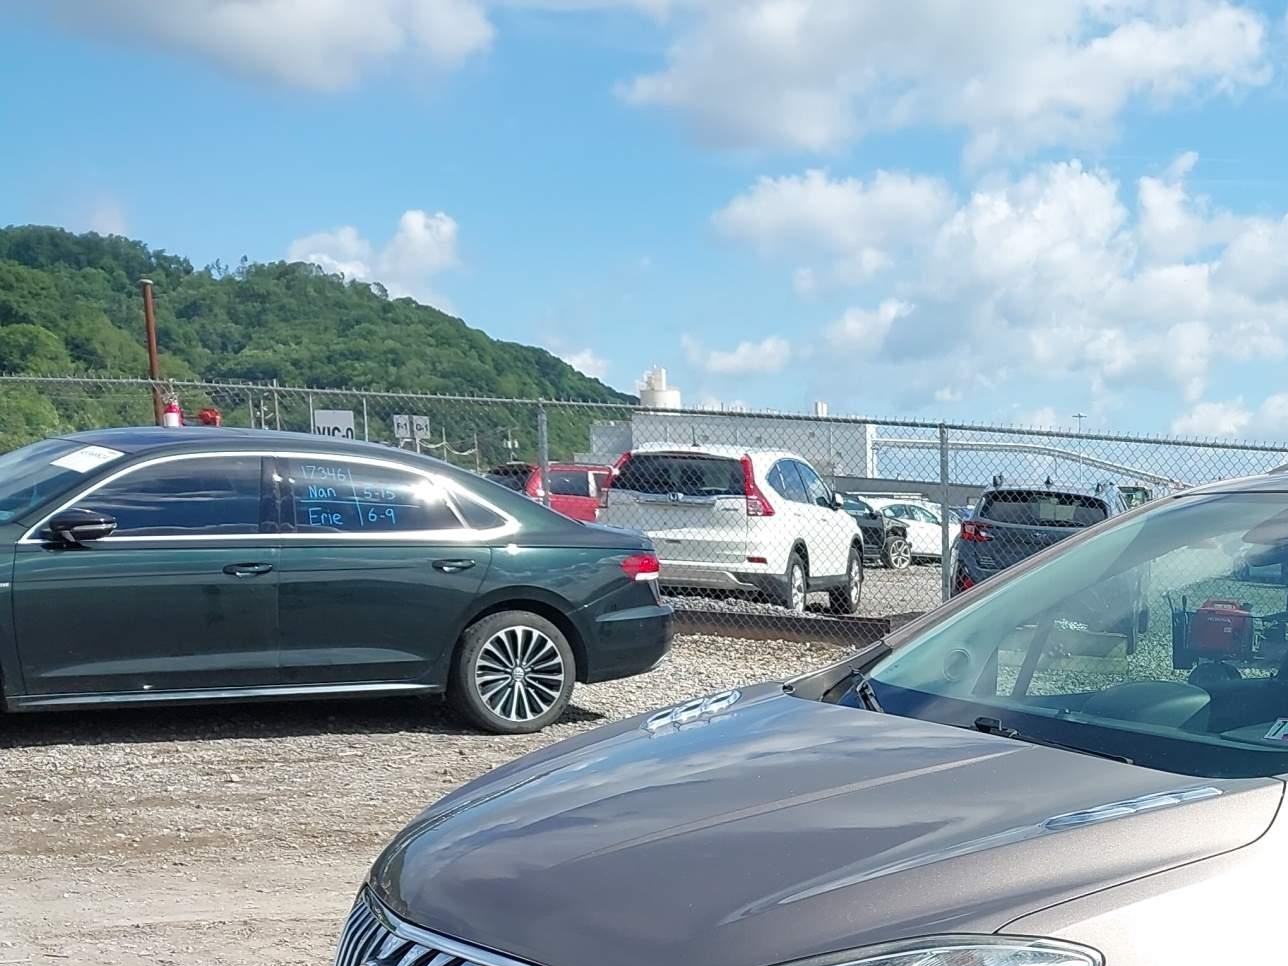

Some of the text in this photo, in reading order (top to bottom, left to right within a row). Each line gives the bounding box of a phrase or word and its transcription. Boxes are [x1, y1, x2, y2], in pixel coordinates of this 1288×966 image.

[308, 485, 337, 498] Nan
[308, 507, 396, 526] Erie 6-9
[1271, 721, 1288, 737] 7
